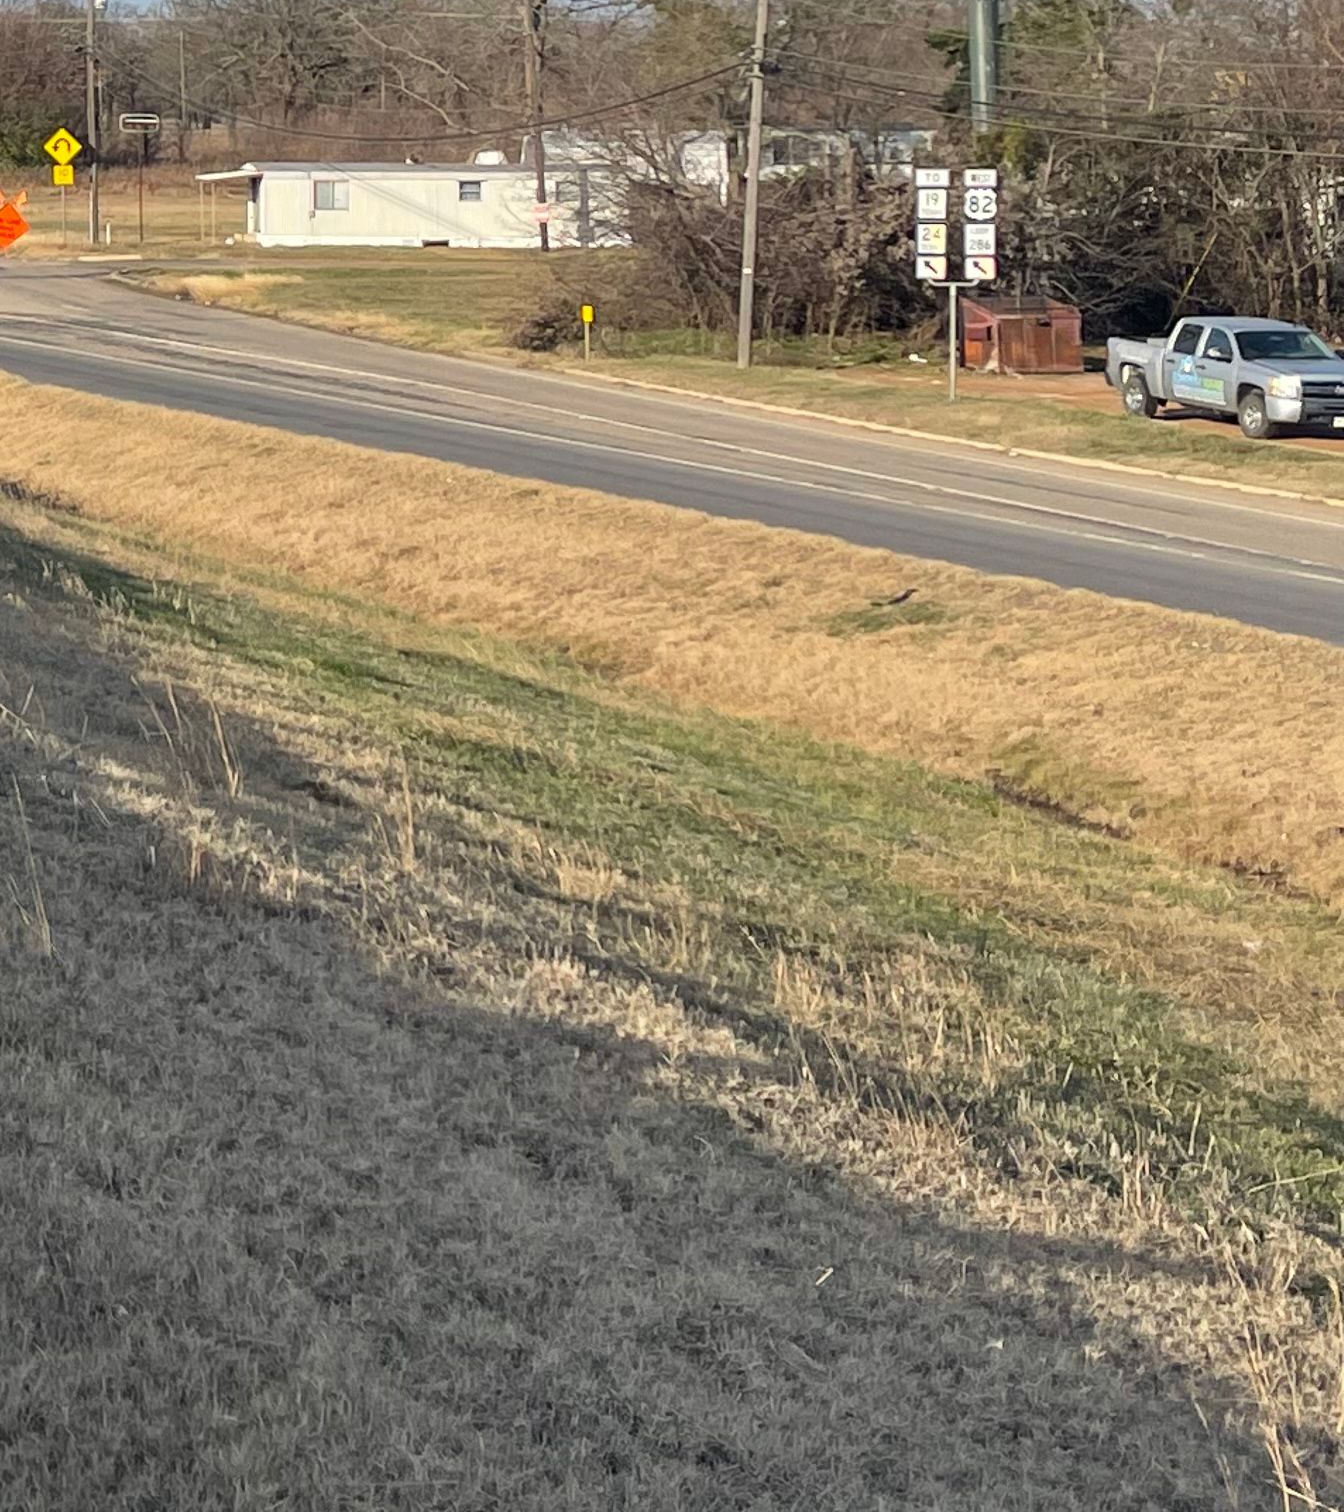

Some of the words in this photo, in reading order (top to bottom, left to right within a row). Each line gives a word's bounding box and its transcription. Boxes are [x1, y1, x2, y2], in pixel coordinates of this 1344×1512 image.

[925, 173, 941, 183] TO
[925, 192, 939, 206] 19
[969, 195, 994, 214] 82
[969, 239, 991, 251] 286
